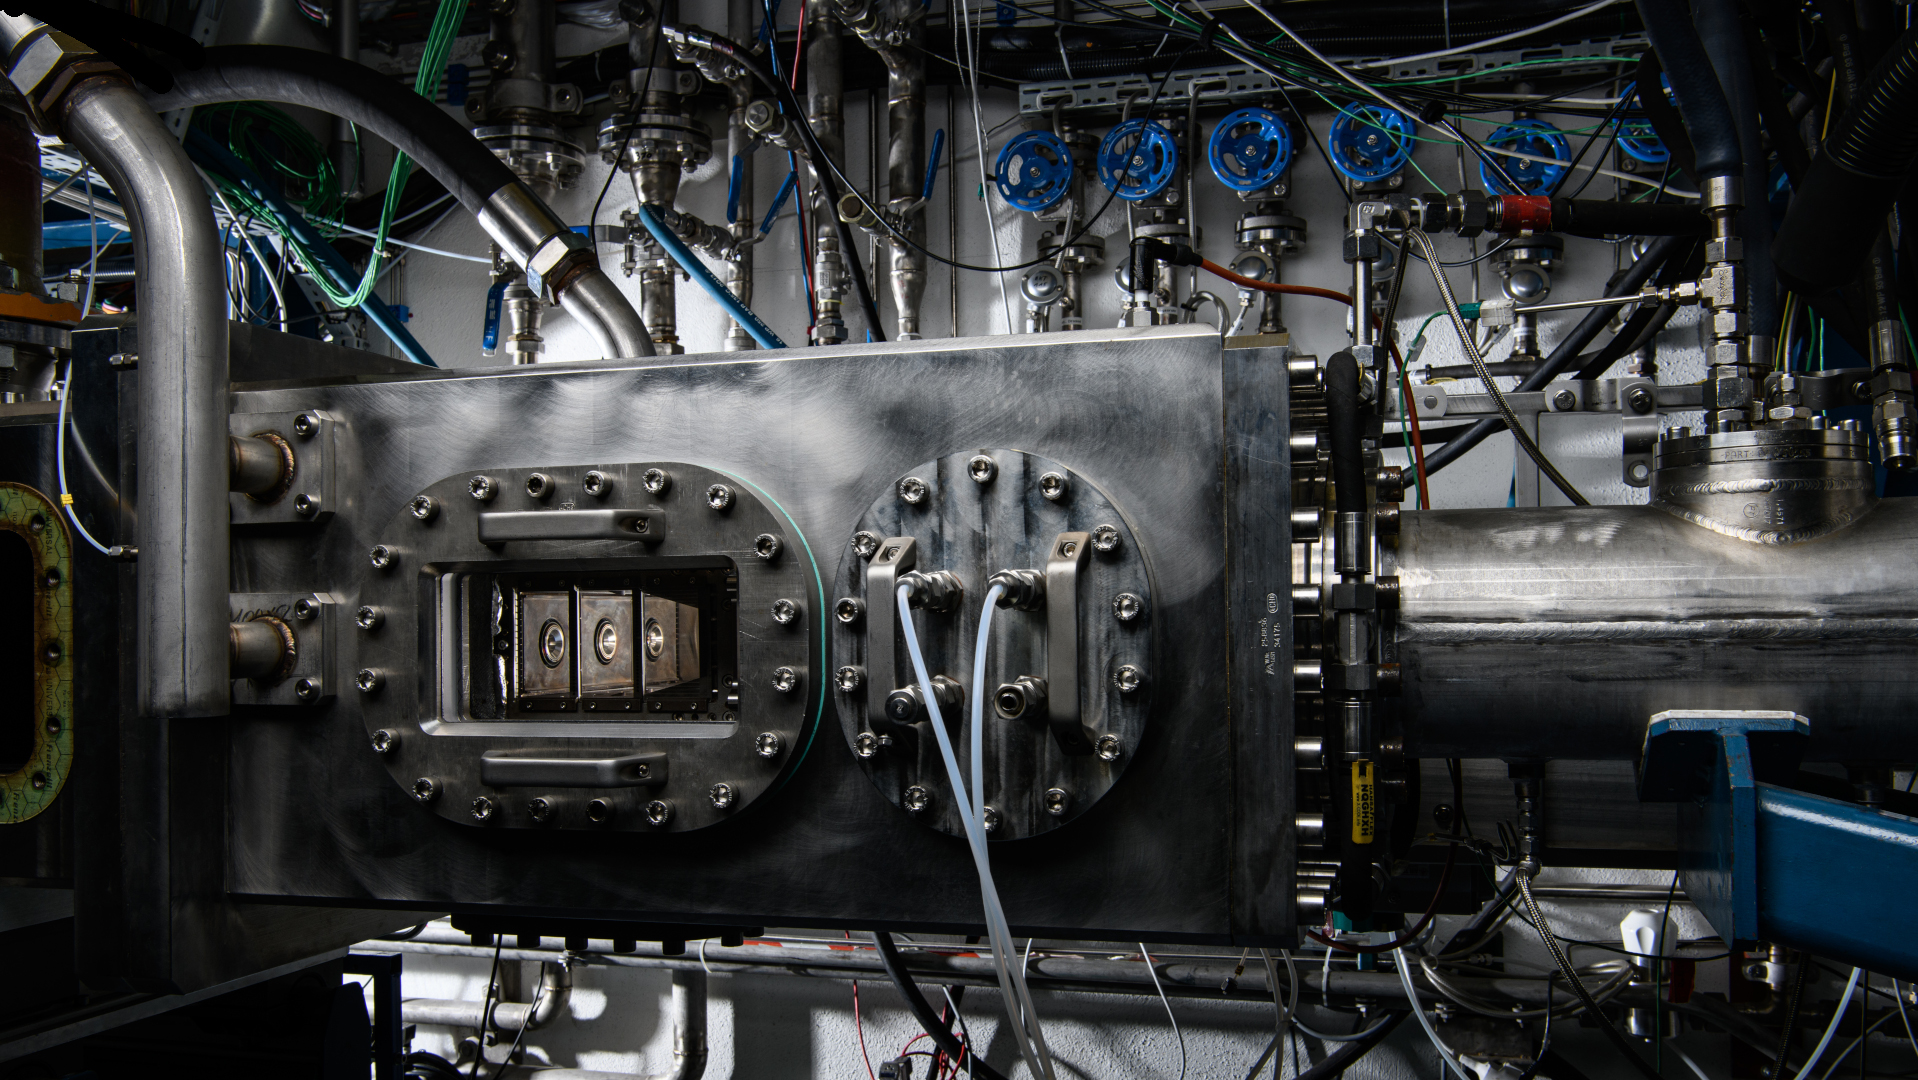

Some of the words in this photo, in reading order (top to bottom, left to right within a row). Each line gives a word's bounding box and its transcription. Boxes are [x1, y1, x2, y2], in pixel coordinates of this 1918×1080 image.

[1843, 43, 1851, 57] Bar
[1846, 69, 1856, 82] WP
[1874, 266, 1883, 280] Bar
[1876, 292, 1886, 305] WP
[740, 303, 754, 317] BAR
[1360, 784, 1370, 836] NQGHXH
